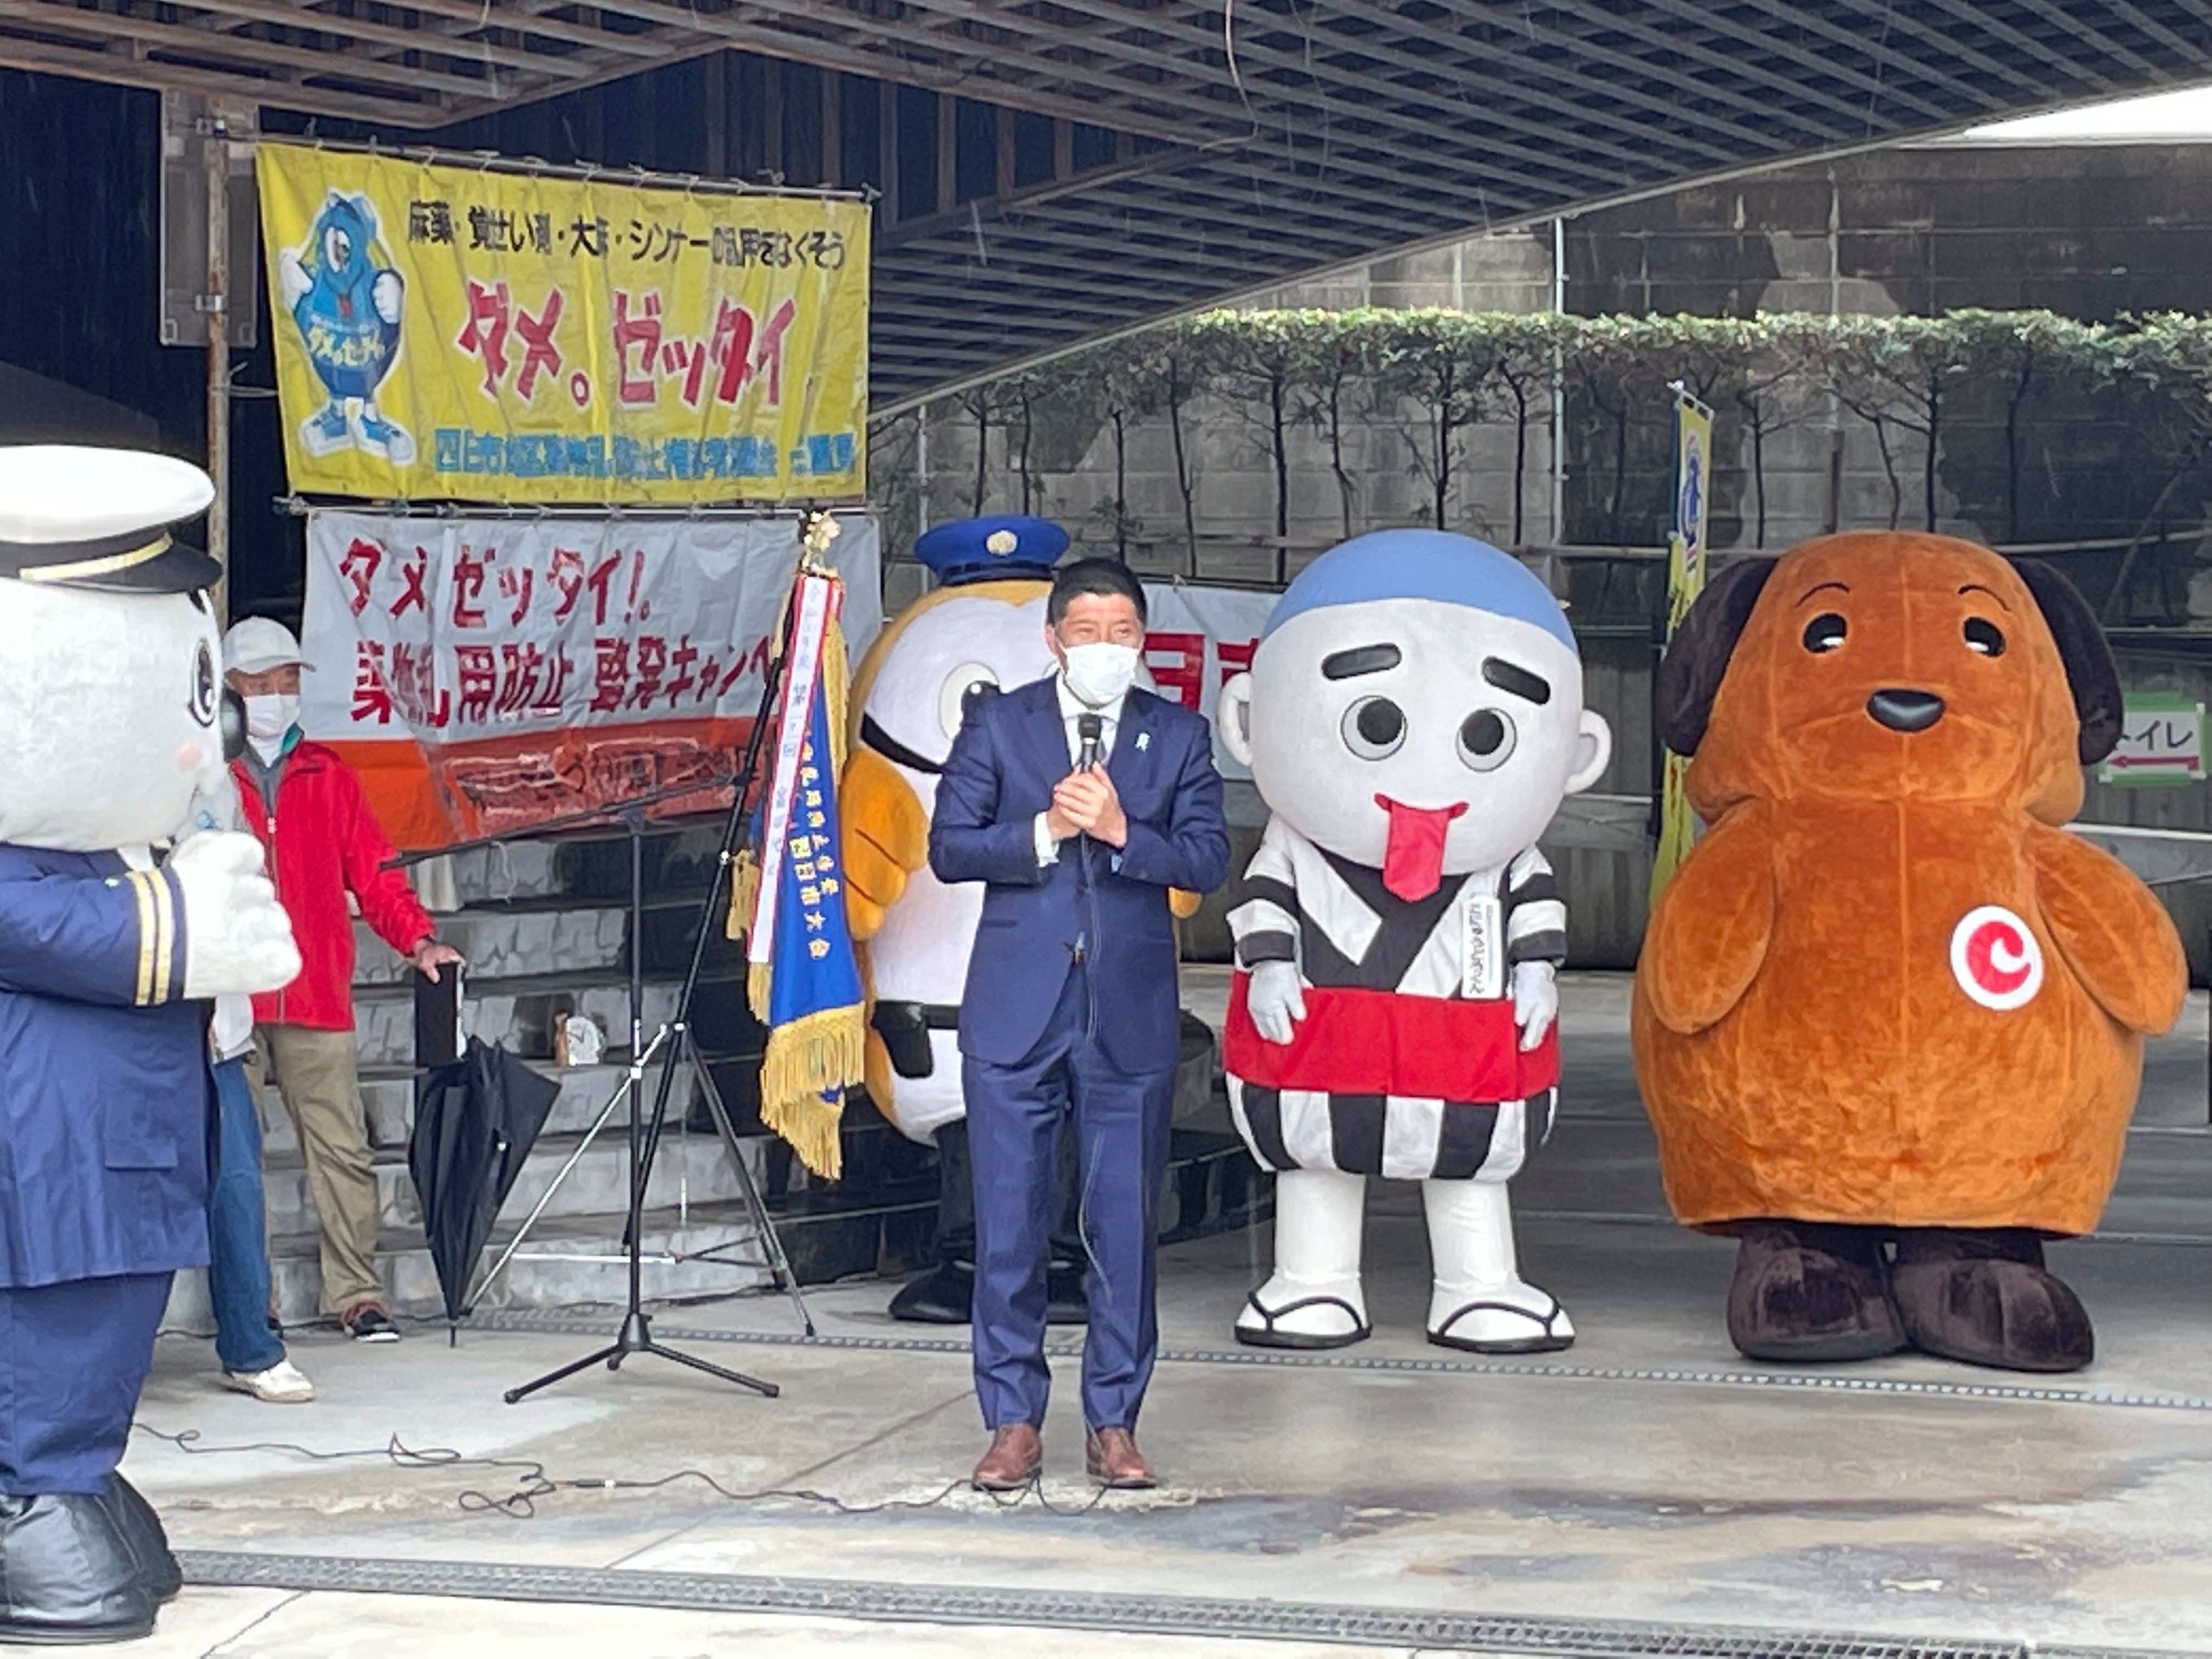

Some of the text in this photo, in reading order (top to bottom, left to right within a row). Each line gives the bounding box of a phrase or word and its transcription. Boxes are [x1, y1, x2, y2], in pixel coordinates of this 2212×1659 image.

[459, 280, 814, 407] ダメ。ゼッタイ
[2121, 720, 2193, 752] イレ
